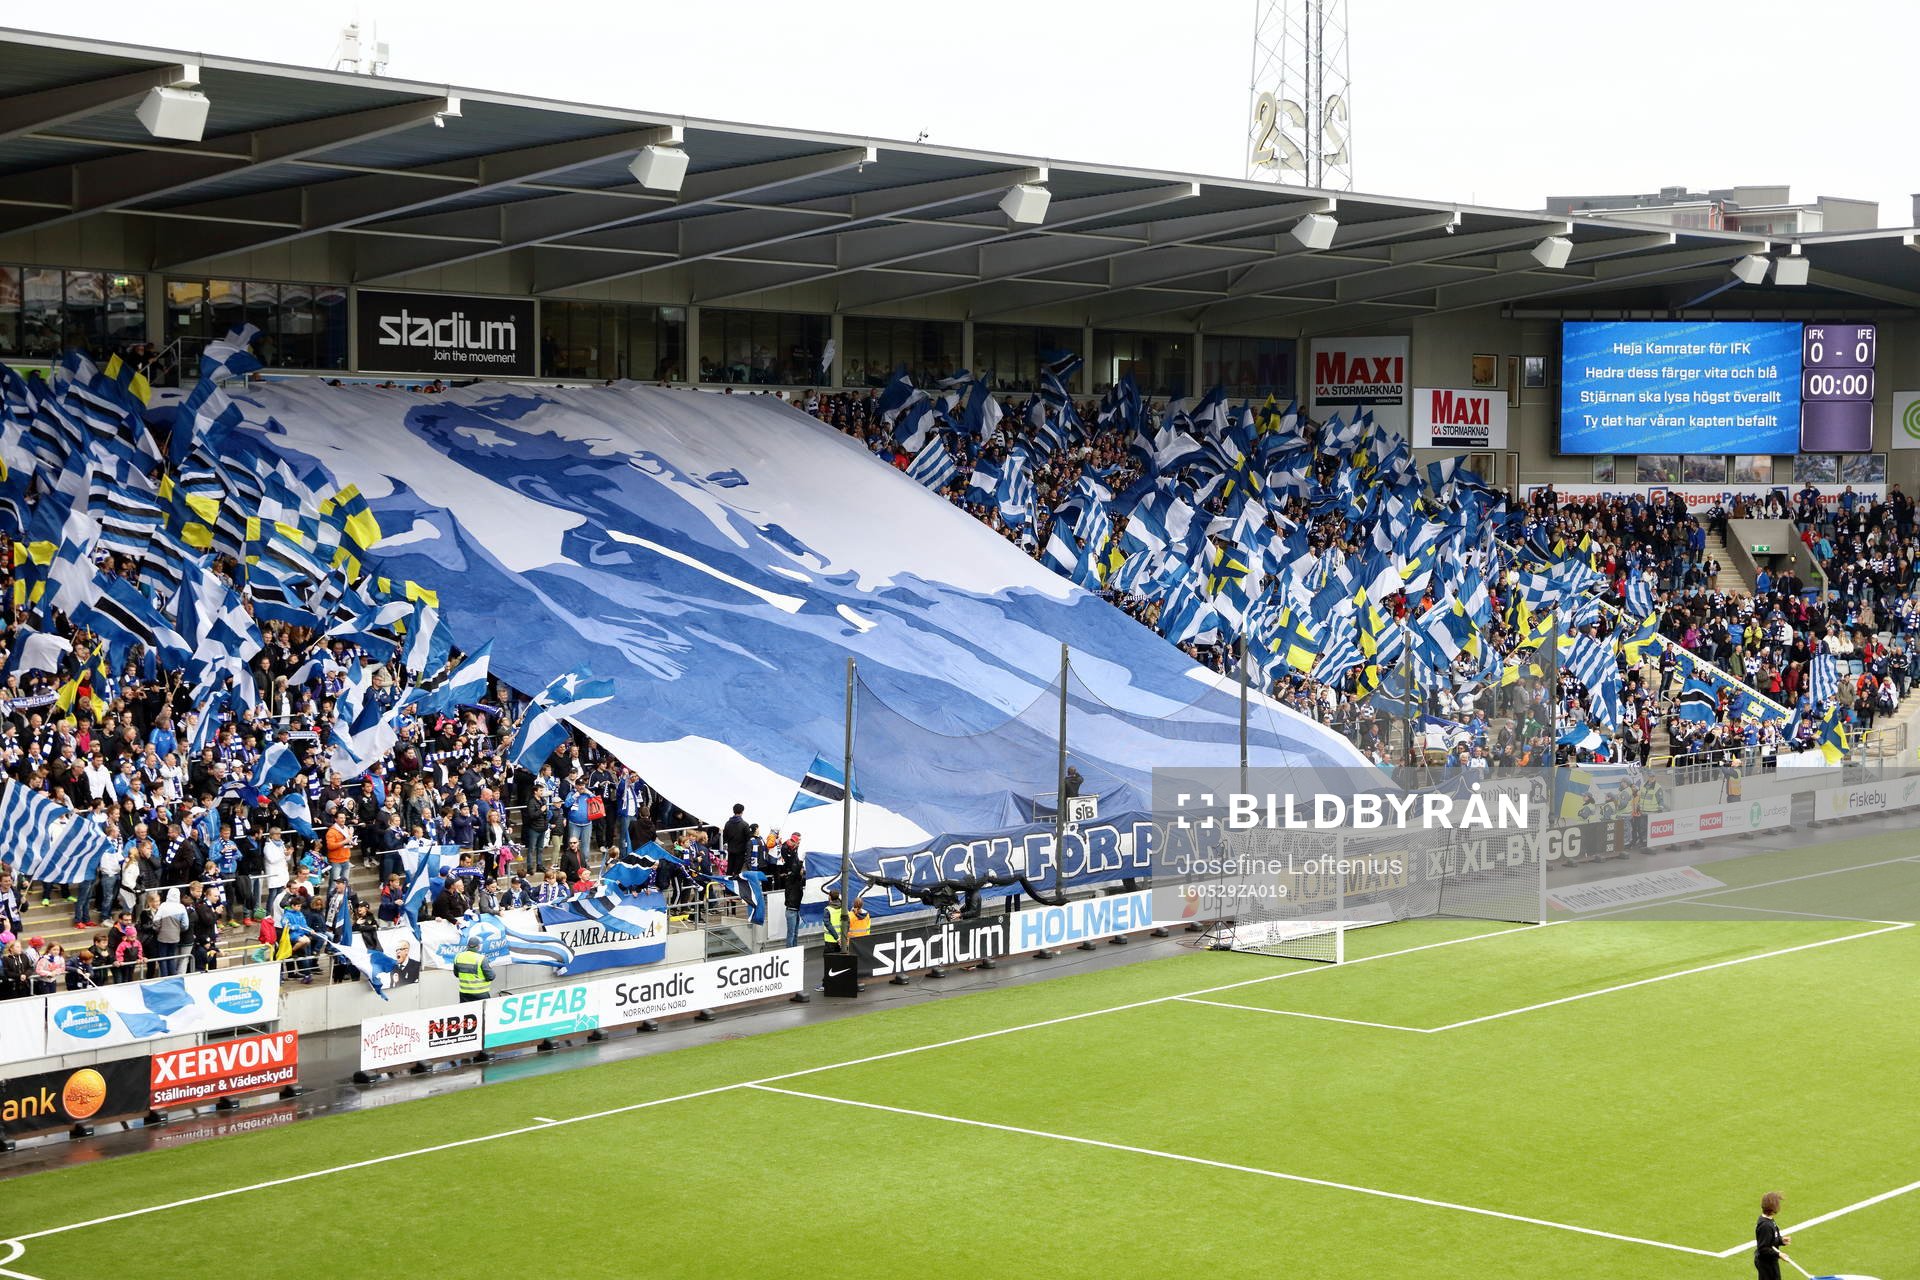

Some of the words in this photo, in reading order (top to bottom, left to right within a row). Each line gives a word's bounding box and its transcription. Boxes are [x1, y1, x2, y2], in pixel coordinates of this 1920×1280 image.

[379, 309, 516, 351] stadium
[1808, 329, 1824, 340] IFK
[1857, 329, 1873, 340] IFE
[433, 350, 451, 361] Join
[452, 350, 468, 362] the
[469, 352, 516, 364] movement
[1613, 343, 1642, 356] Heja
[1646, 343, 1707, 355] Kamrater
[1708, 342, 1727, 355] för
[1730, 343, 1751, 355] IFK
[1810, 342, 1823, 363] 0
[1855, 342, 1868, 363] 0
[1315, 352, 1403, 384] MAXI
[1585, 366, 1625, 379] Hedra
[1627, 366, 1658, 379] dess
[1661, 366, 1701, 381] färger
[1704, 367, 1727, 379] vita
[1730, 367, 1754, 379] och
[1757, 365, 1777, 379] blå
[1316, 386, 1330, 396] ICA
[1331, 385, 1403, 396] STORMARKNAD
[1809, 374, 1868, 396] 00:00
[1431, 390, 1490, 425] MAXI
[1580, 390, 1635, 405] Stjärnan
[1638, 391, 1661, 403] ska
[1664, 391, 1690, 405] lysa
[1691, 391, 1730, 405] högst
[1732, 391, 1781, 403] överallt
[1431, 425, 1441, 435] ICA
[1442, 425, 1489, 436] STORMARKNAD
[1583, 415, 1599, 429] Ty
[1601, 415, 1622, 427] det
[1625, 415, 1646, 427] har
[1649, 413, 1685, 427] våran
[1689, 415, 1734, 428] kapten
[1736, 415, 1778, 427] befallt
[1849, 788, 1887, 809] Fiskeby
[1651, 823, 1673, 836] RICOH
[1700, 816, 1722, 827] RICOH
[1023, 821, 1124, 882] FÖR
[1461, 827, 1581, 875] XL-BYGG
[1021, 894, 1153, 949] HOLMEN
[872, 923, 1004, 977] stadium
[717, 956, 790, 989] Scandic
[615, 972, 694, 1007] Scandic
[723, 986, 764, 1000] NORRKÖPING
[764, 982, 783, 992] NORD
[499, 986, 588, 1025] SEFAB
[623, 1003, 667, 1018] NORRKÖPING
[667, 1000, 687, 1010] NORD
[363, 1021, 421, 1051] Norrköpings
[428, 1014, 478, 1040] NBD
[372, 1042, 412, 1061] Tryckeri
[154, 1083, 216, 1104] Ställningar
[218, 1080, 228, 1091] &
[230, 1067, 294, 1089] Väderskydd
[2, 1087, 57, 1122] ank
